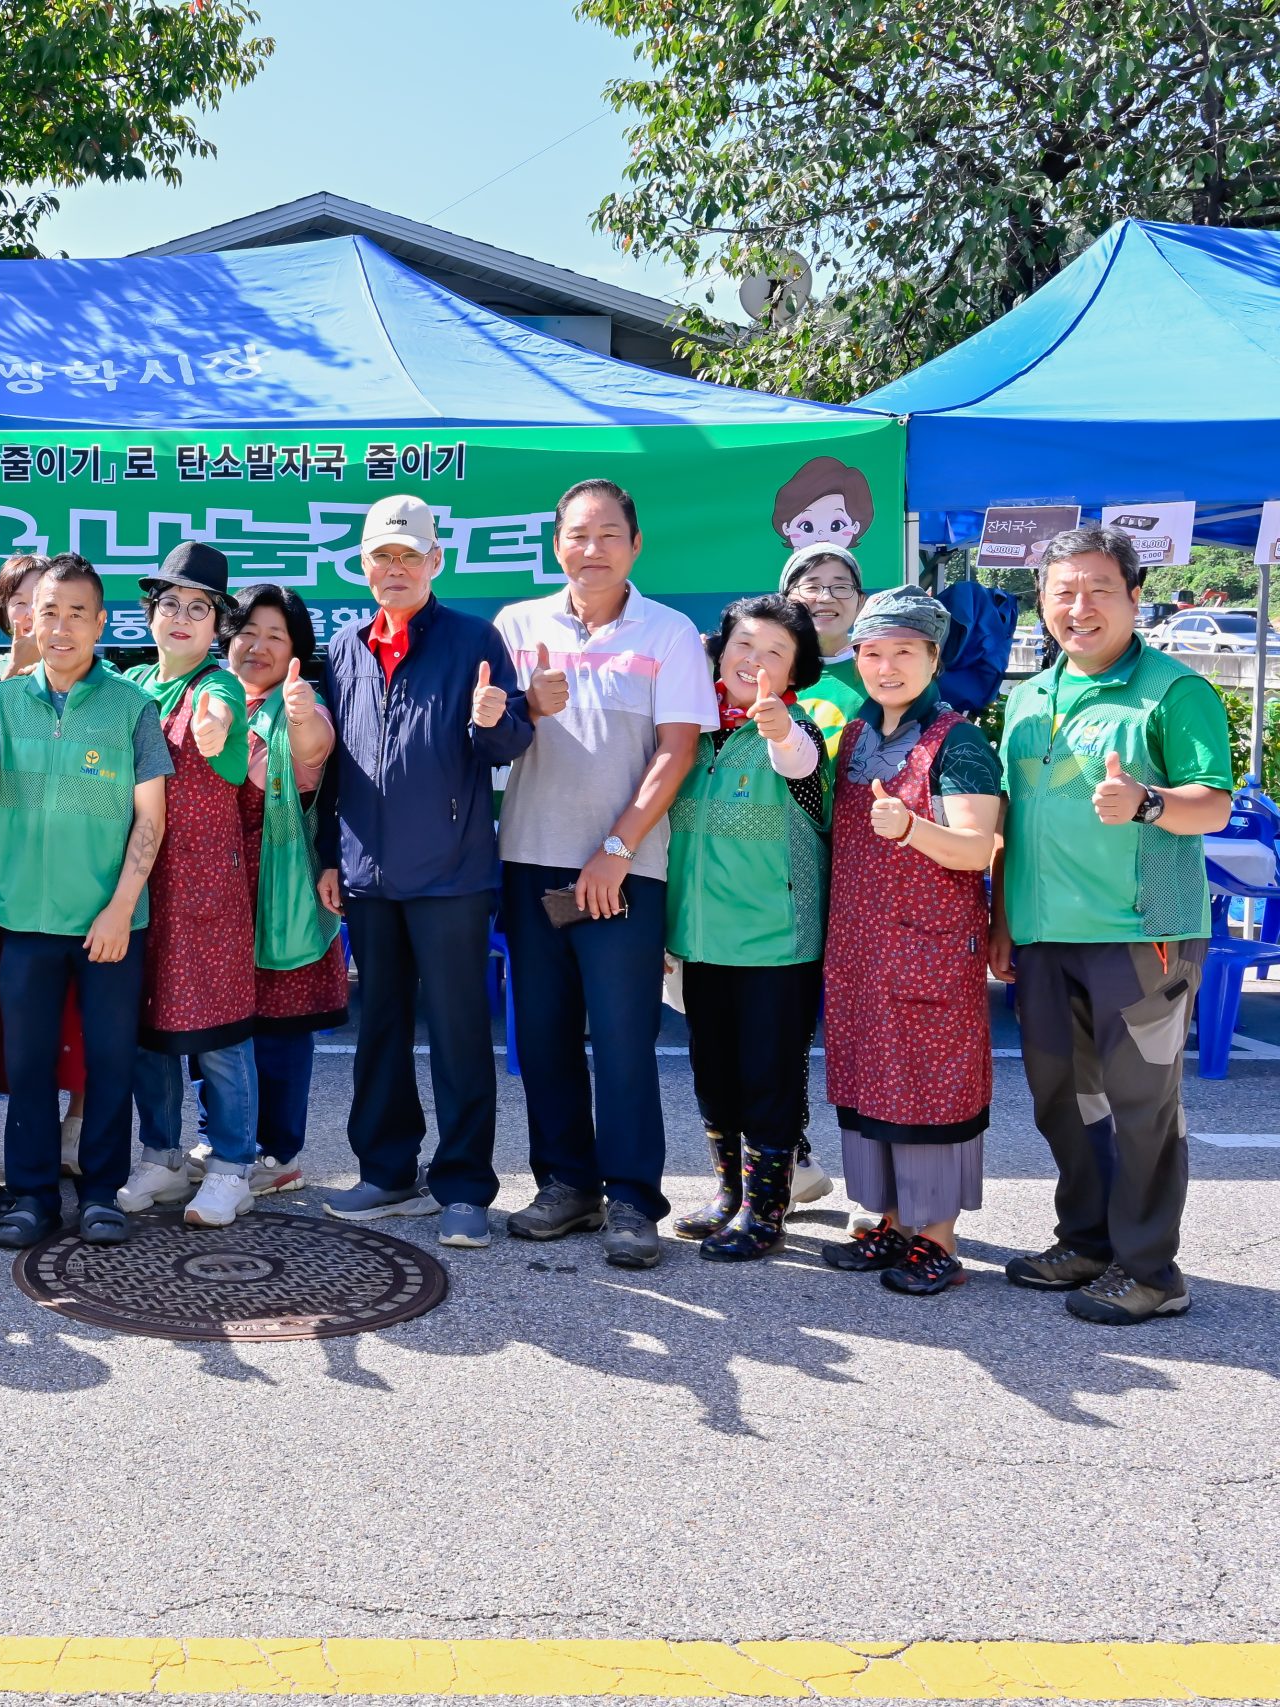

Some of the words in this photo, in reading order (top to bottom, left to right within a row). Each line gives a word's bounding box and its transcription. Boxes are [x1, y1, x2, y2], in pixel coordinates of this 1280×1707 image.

[176, 444, 347, 481] 탄소발자국
[363, 441, 467, 481] 줄이기
[386, 518, 407, 527] Jeep
[987, 520, 1037, 533] 잔치국수
[1141, 539, 1167, 549] 3,000
[986, 545, 1021, 555] 4,000원
[80, 766, 99, 776] SMU
